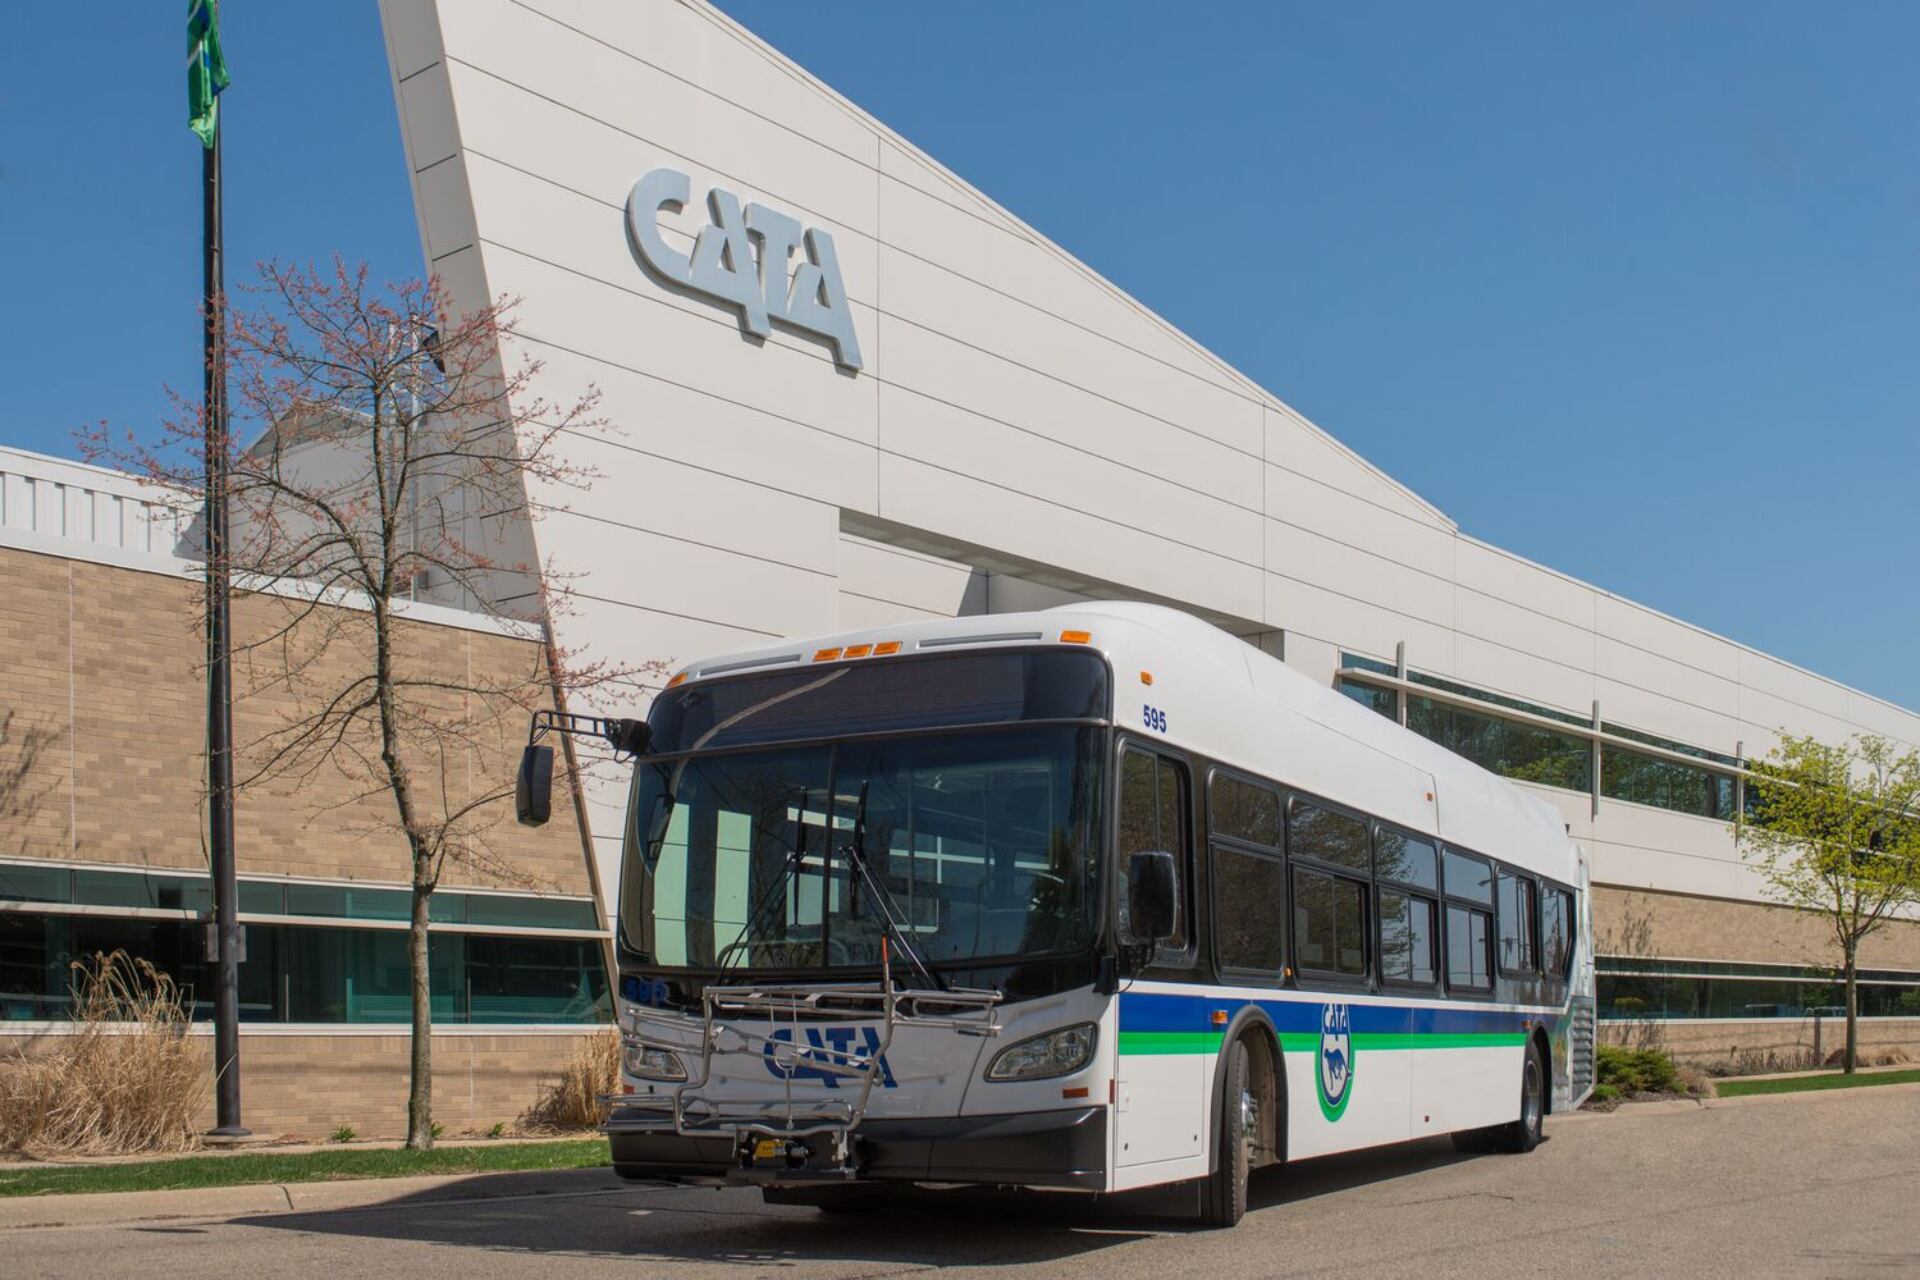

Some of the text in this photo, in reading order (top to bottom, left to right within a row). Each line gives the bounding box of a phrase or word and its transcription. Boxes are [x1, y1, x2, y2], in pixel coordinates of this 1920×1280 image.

[624, 168, 863, 379] CATA
[1143, 704, 1167, 733] 595
[1322, 1003, 1350, 1041] CATA
[763, 1027, 898, 1088] CATA
